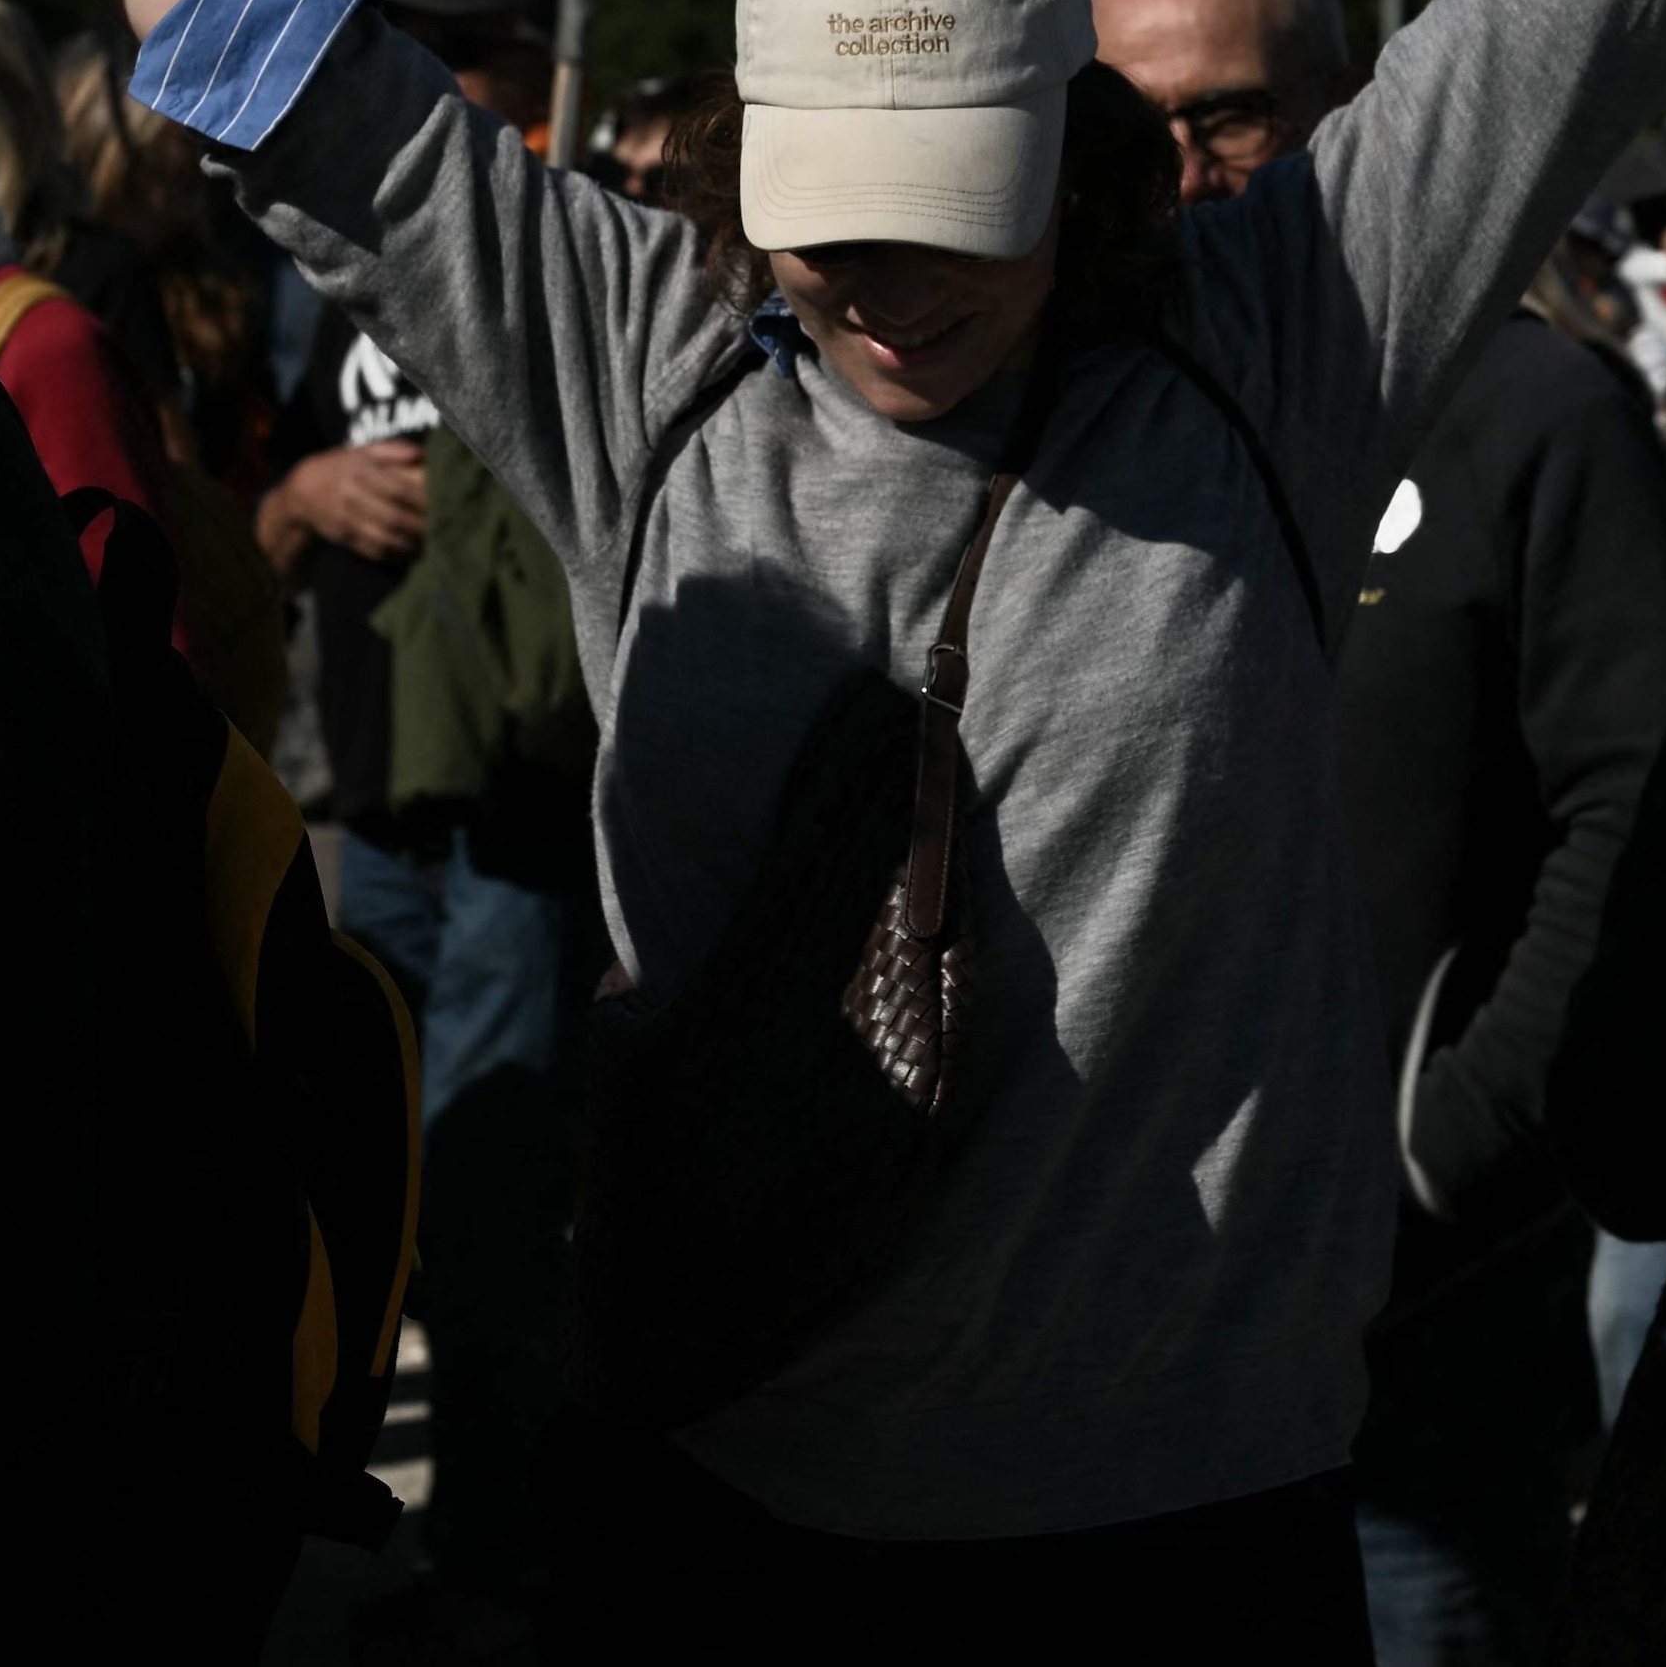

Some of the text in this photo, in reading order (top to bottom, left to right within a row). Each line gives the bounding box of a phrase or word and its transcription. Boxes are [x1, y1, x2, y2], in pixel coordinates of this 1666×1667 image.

[827, 6, 956, 34] the archive
[835, 33, 950, 56] collection
